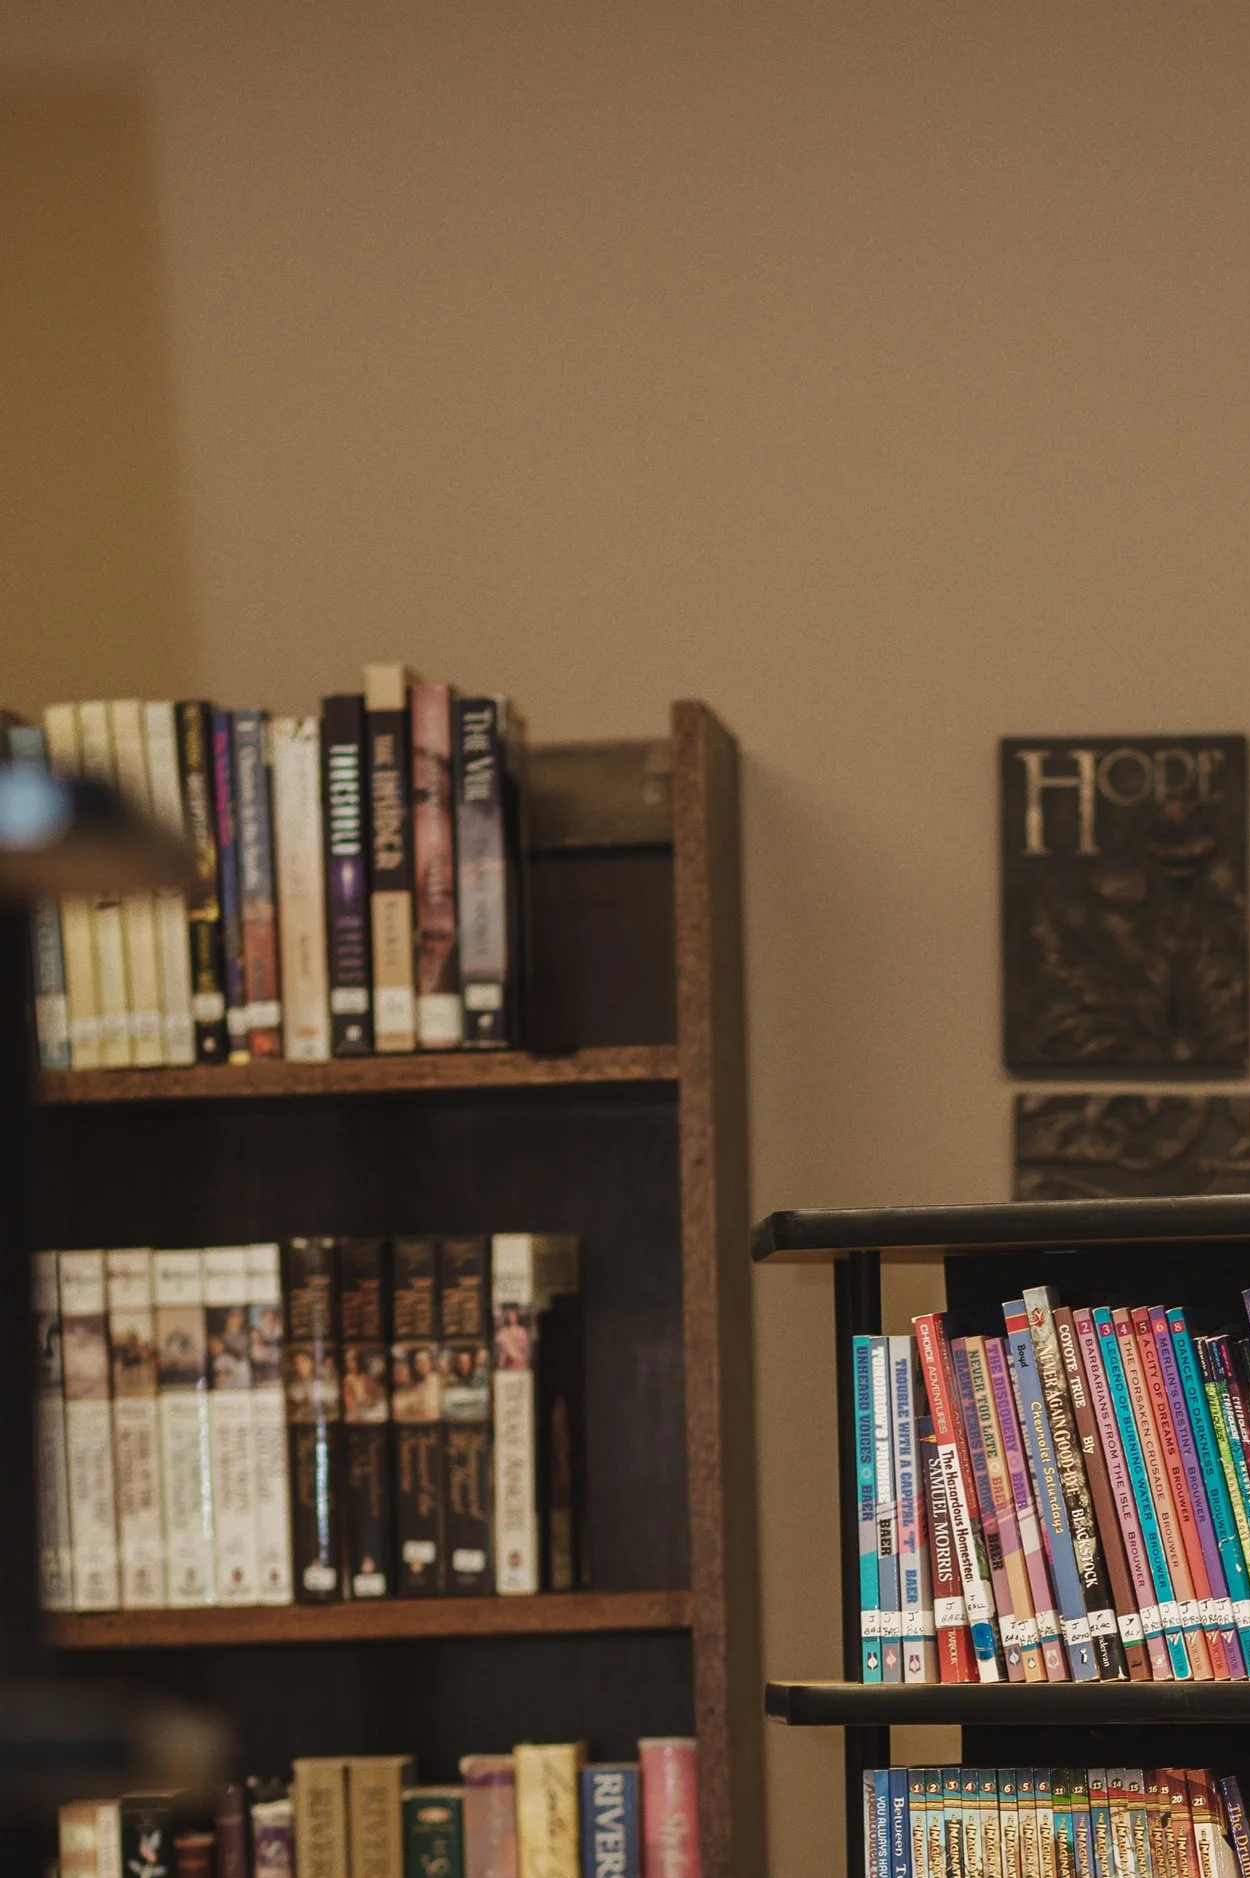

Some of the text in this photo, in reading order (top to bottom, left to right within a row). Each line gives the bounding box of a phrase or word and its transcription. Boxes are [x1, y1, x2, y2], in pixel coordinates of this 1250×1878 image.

[895, 1359, 910, 1460] TROUBLE WITH
[920, 1324, 948, 1434] CHOICE ADVENTURES
[970, 1350, 997, 1458] NEVER LATE
[1017, 1344, 1029, 1368] Boyd
[1058, 1324, 1094, 1454] COYOTE TRUE Bly
[1176, 1340, 1214, 1476] DANCE DARKNESS
[857, 1346, 873, 1521] UNHEARD VOICES BAER
[1085, 1339, 1146, 1587] BARBARIANS BROUWER
[1105, 1341, 1167, 1588] LEGEND BURNING BROUWER
[928, 1457, 953, 1582] SAMUEL MORRIS
[1071, 1509, 1098, 1588] BLACKSTOCK
[905, 1569, 918, 1604] BAER
[893, 1797, 905, 1856] Between
[1231, 1803, 1242, 1832] The
